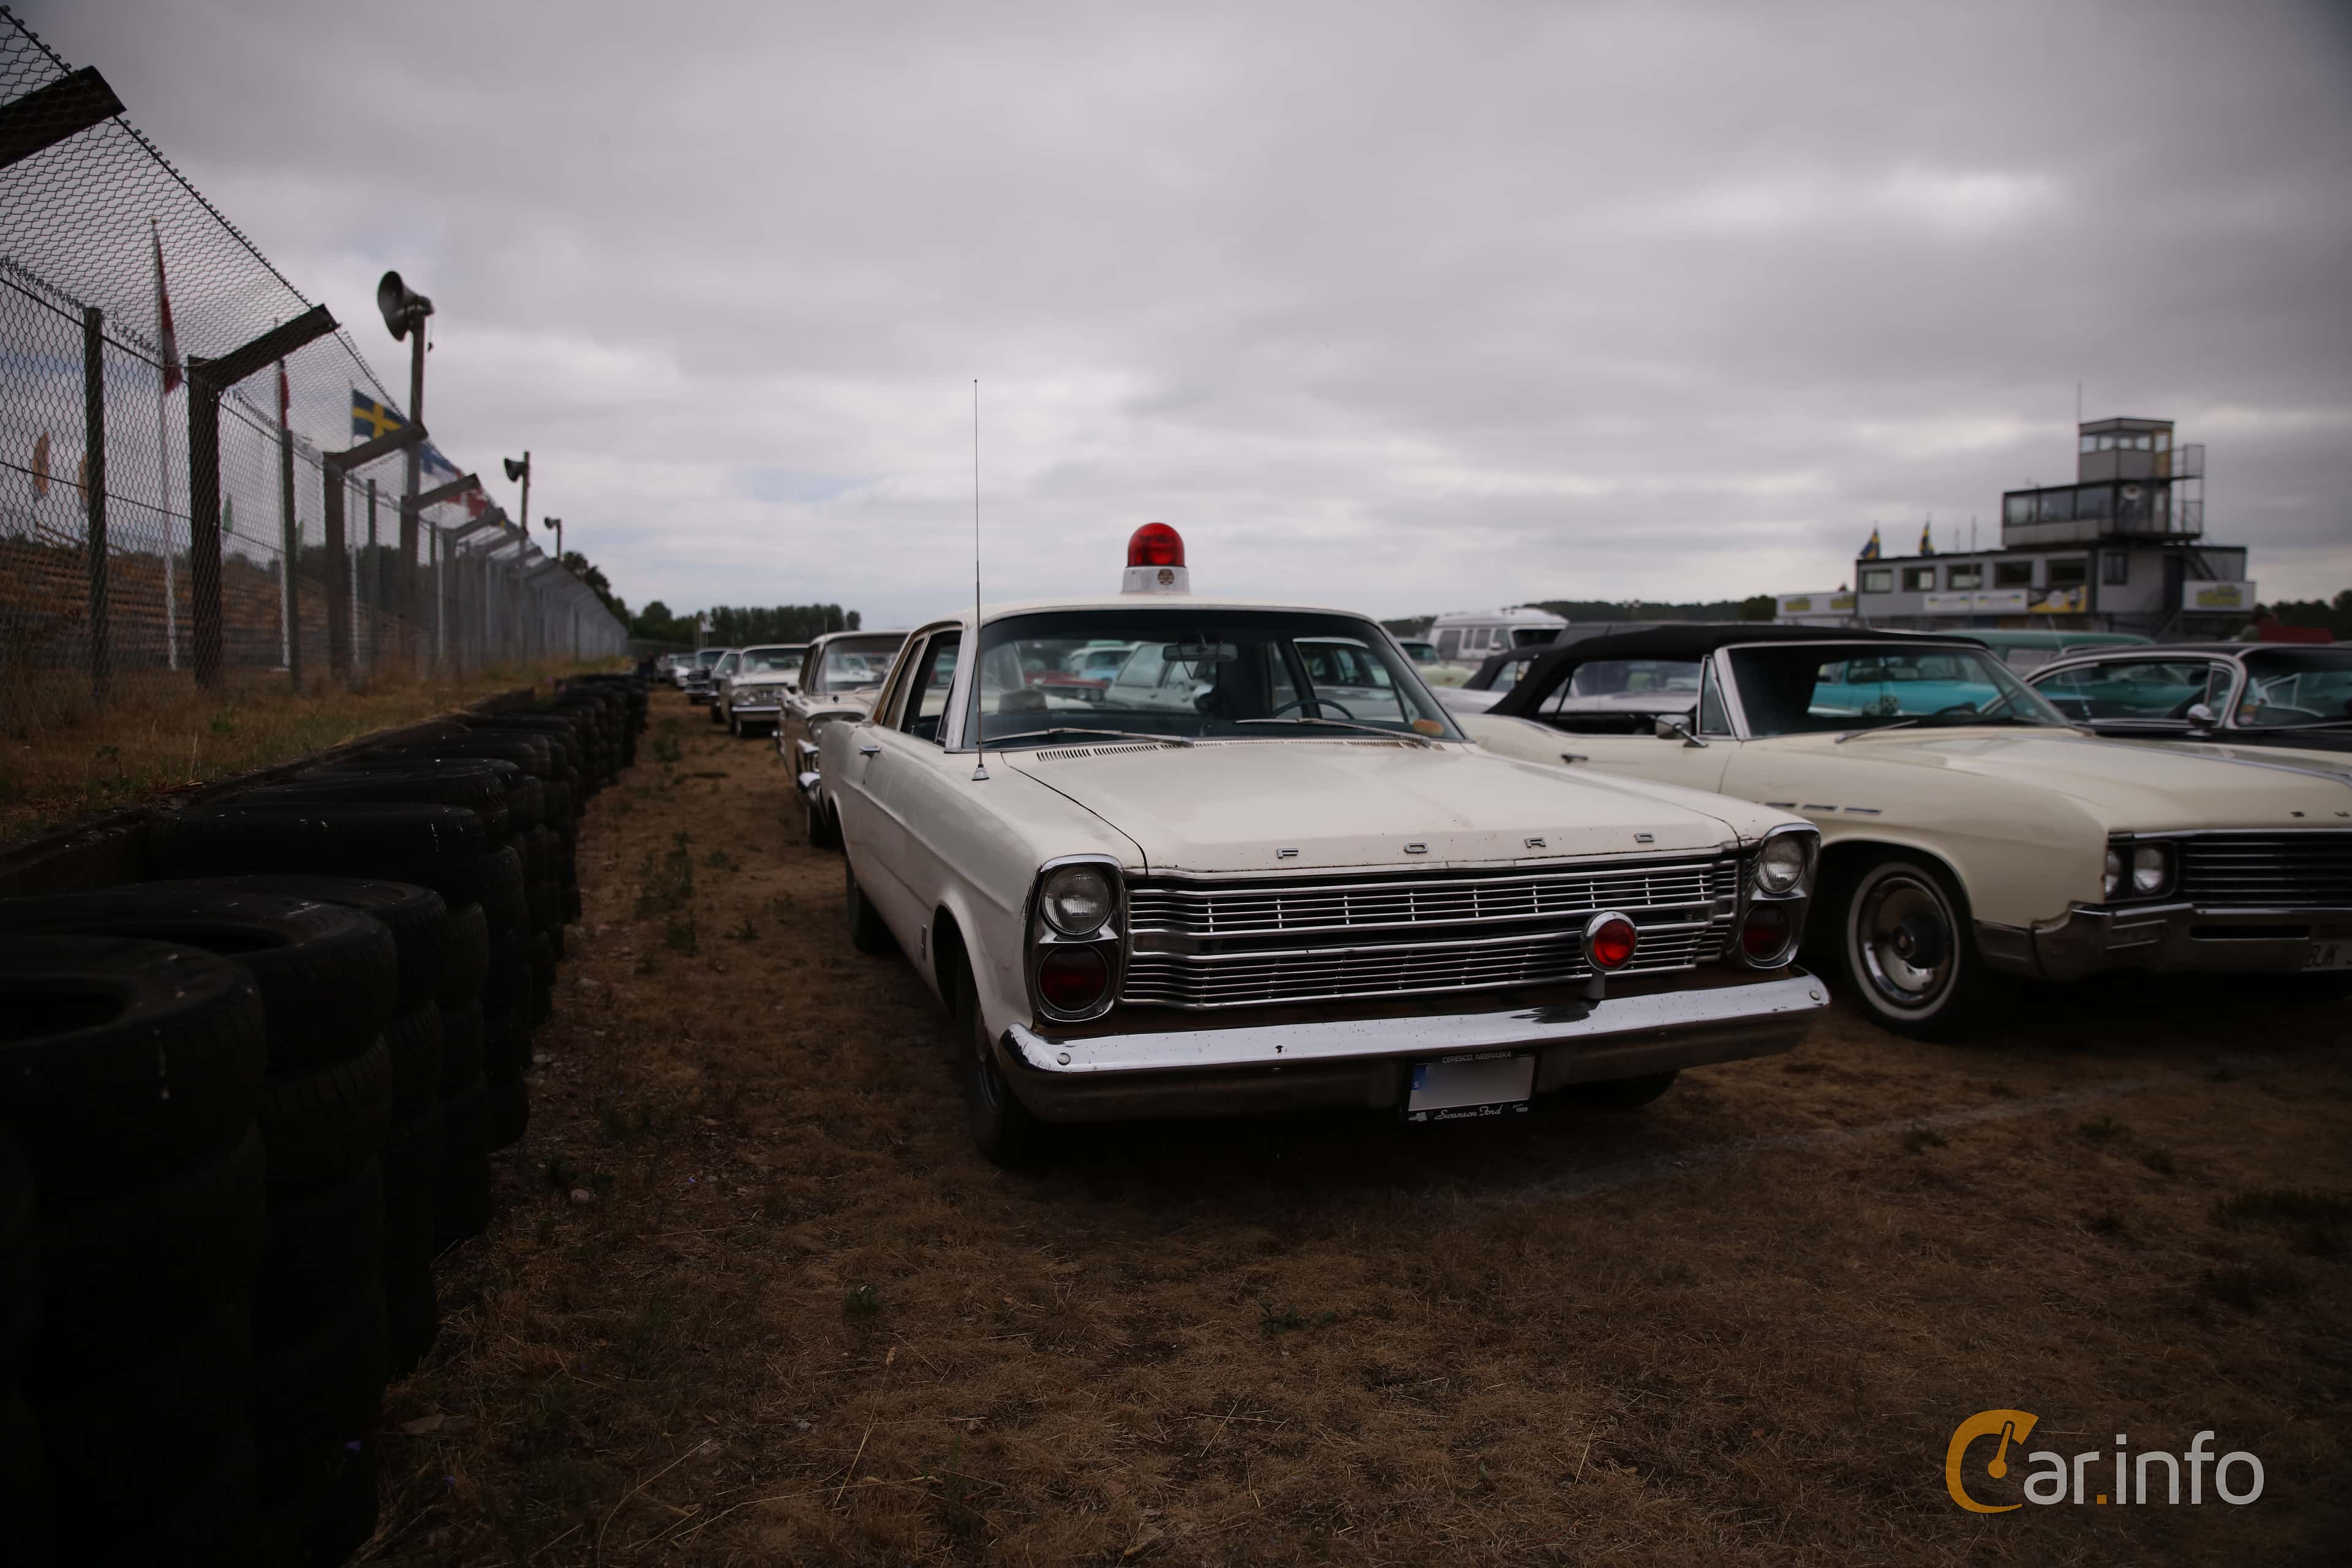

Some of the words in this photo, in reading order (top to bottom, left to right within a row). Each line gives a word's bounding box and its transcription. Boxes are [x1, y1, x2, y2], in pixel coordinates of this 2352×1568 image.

[1276, 833, 1654, 859] FORD
[1476, 1051, 1511, 1060] NEBRASKA
[1434, 1110, 1477, 1120] Swanson
[1479, 1104, 1504, 1117] Ford
